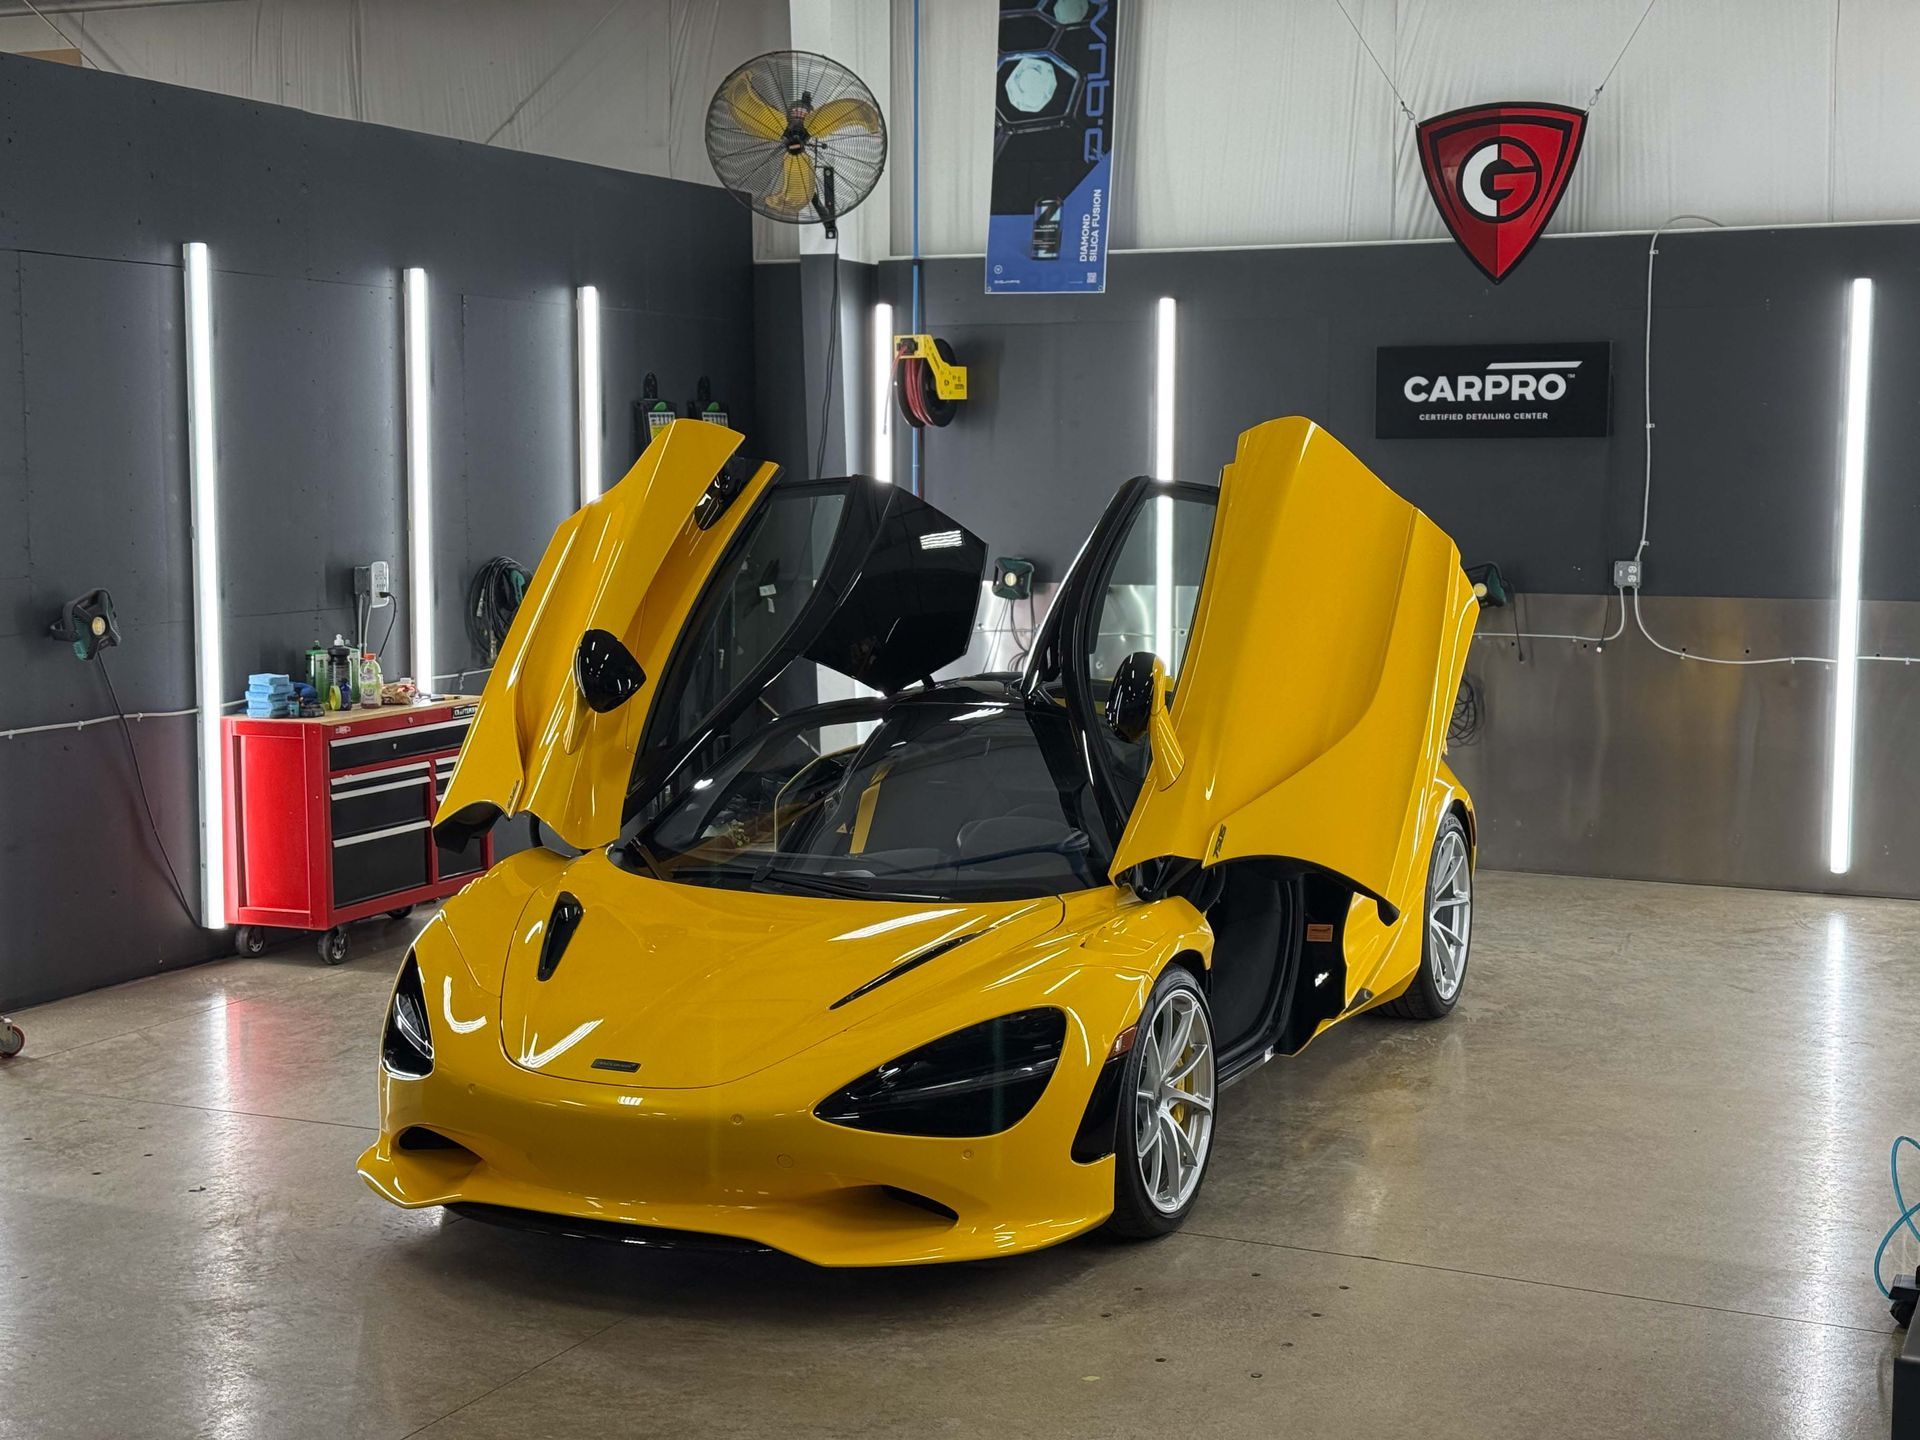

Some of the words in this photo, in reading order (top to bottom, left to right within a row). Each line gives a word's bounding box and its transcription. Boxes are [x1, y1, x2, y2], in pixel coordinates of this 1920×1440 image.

[1092, 188, 1102, 228] FUSION
[1079, 213, 1091, 262] DIAMOND
[1089, 229, 1099, 262] SILICA
[1403, 373, 1567, 402] CARPRO
[1419, 413, 1464, 421] CERTIFIED
[1466, 412, 1511, 421] DETAILING
[1513, 412, 1549, 420] CENTER
